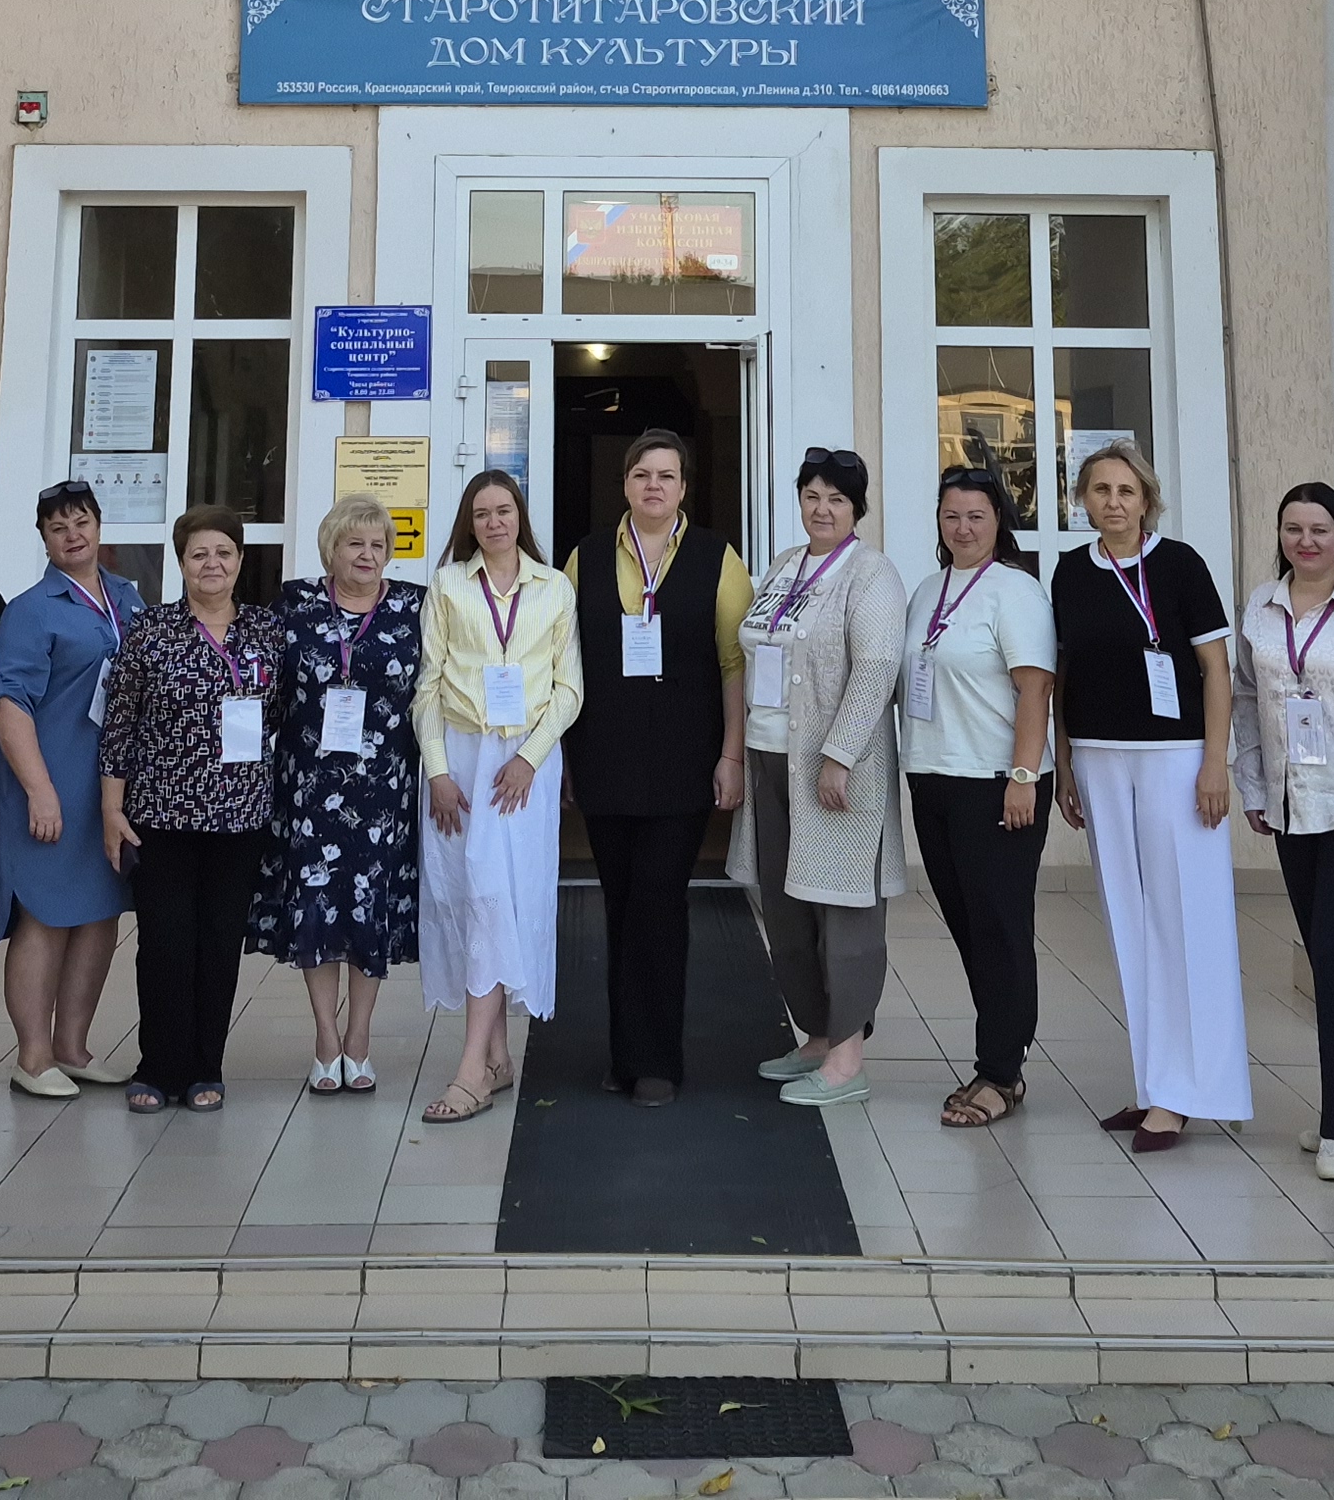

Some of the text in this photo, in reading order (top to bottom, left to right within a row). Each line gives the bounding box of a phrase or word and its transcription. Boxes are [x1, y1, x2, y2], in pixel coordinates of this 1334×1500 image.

[426, 36, 800, 68] ДОМ КУЛЬТУРЫ
[276, 81, 315, 93] 353530
[317, 81, 362, 95] Россия,
[364, 82, 452, 96] Краснодарский
[454, 82, 484, 96] край,
[486, 82, 557, 96] Темрюкский
[559, 83, 597, 97] район,
[599, 85, 630, 96] ст-ца
[631, 83, 739, 97] Старотитаровская,
[741, 84, 800, 98] ул.Ленина
[838, 84, 862, 96] Тел.
[871, 84, 950, 98] 8(86148)90663
[630, 212, 720, 222] УЧАСКОВАЯ
[330, 338, 414, 350] социальный
